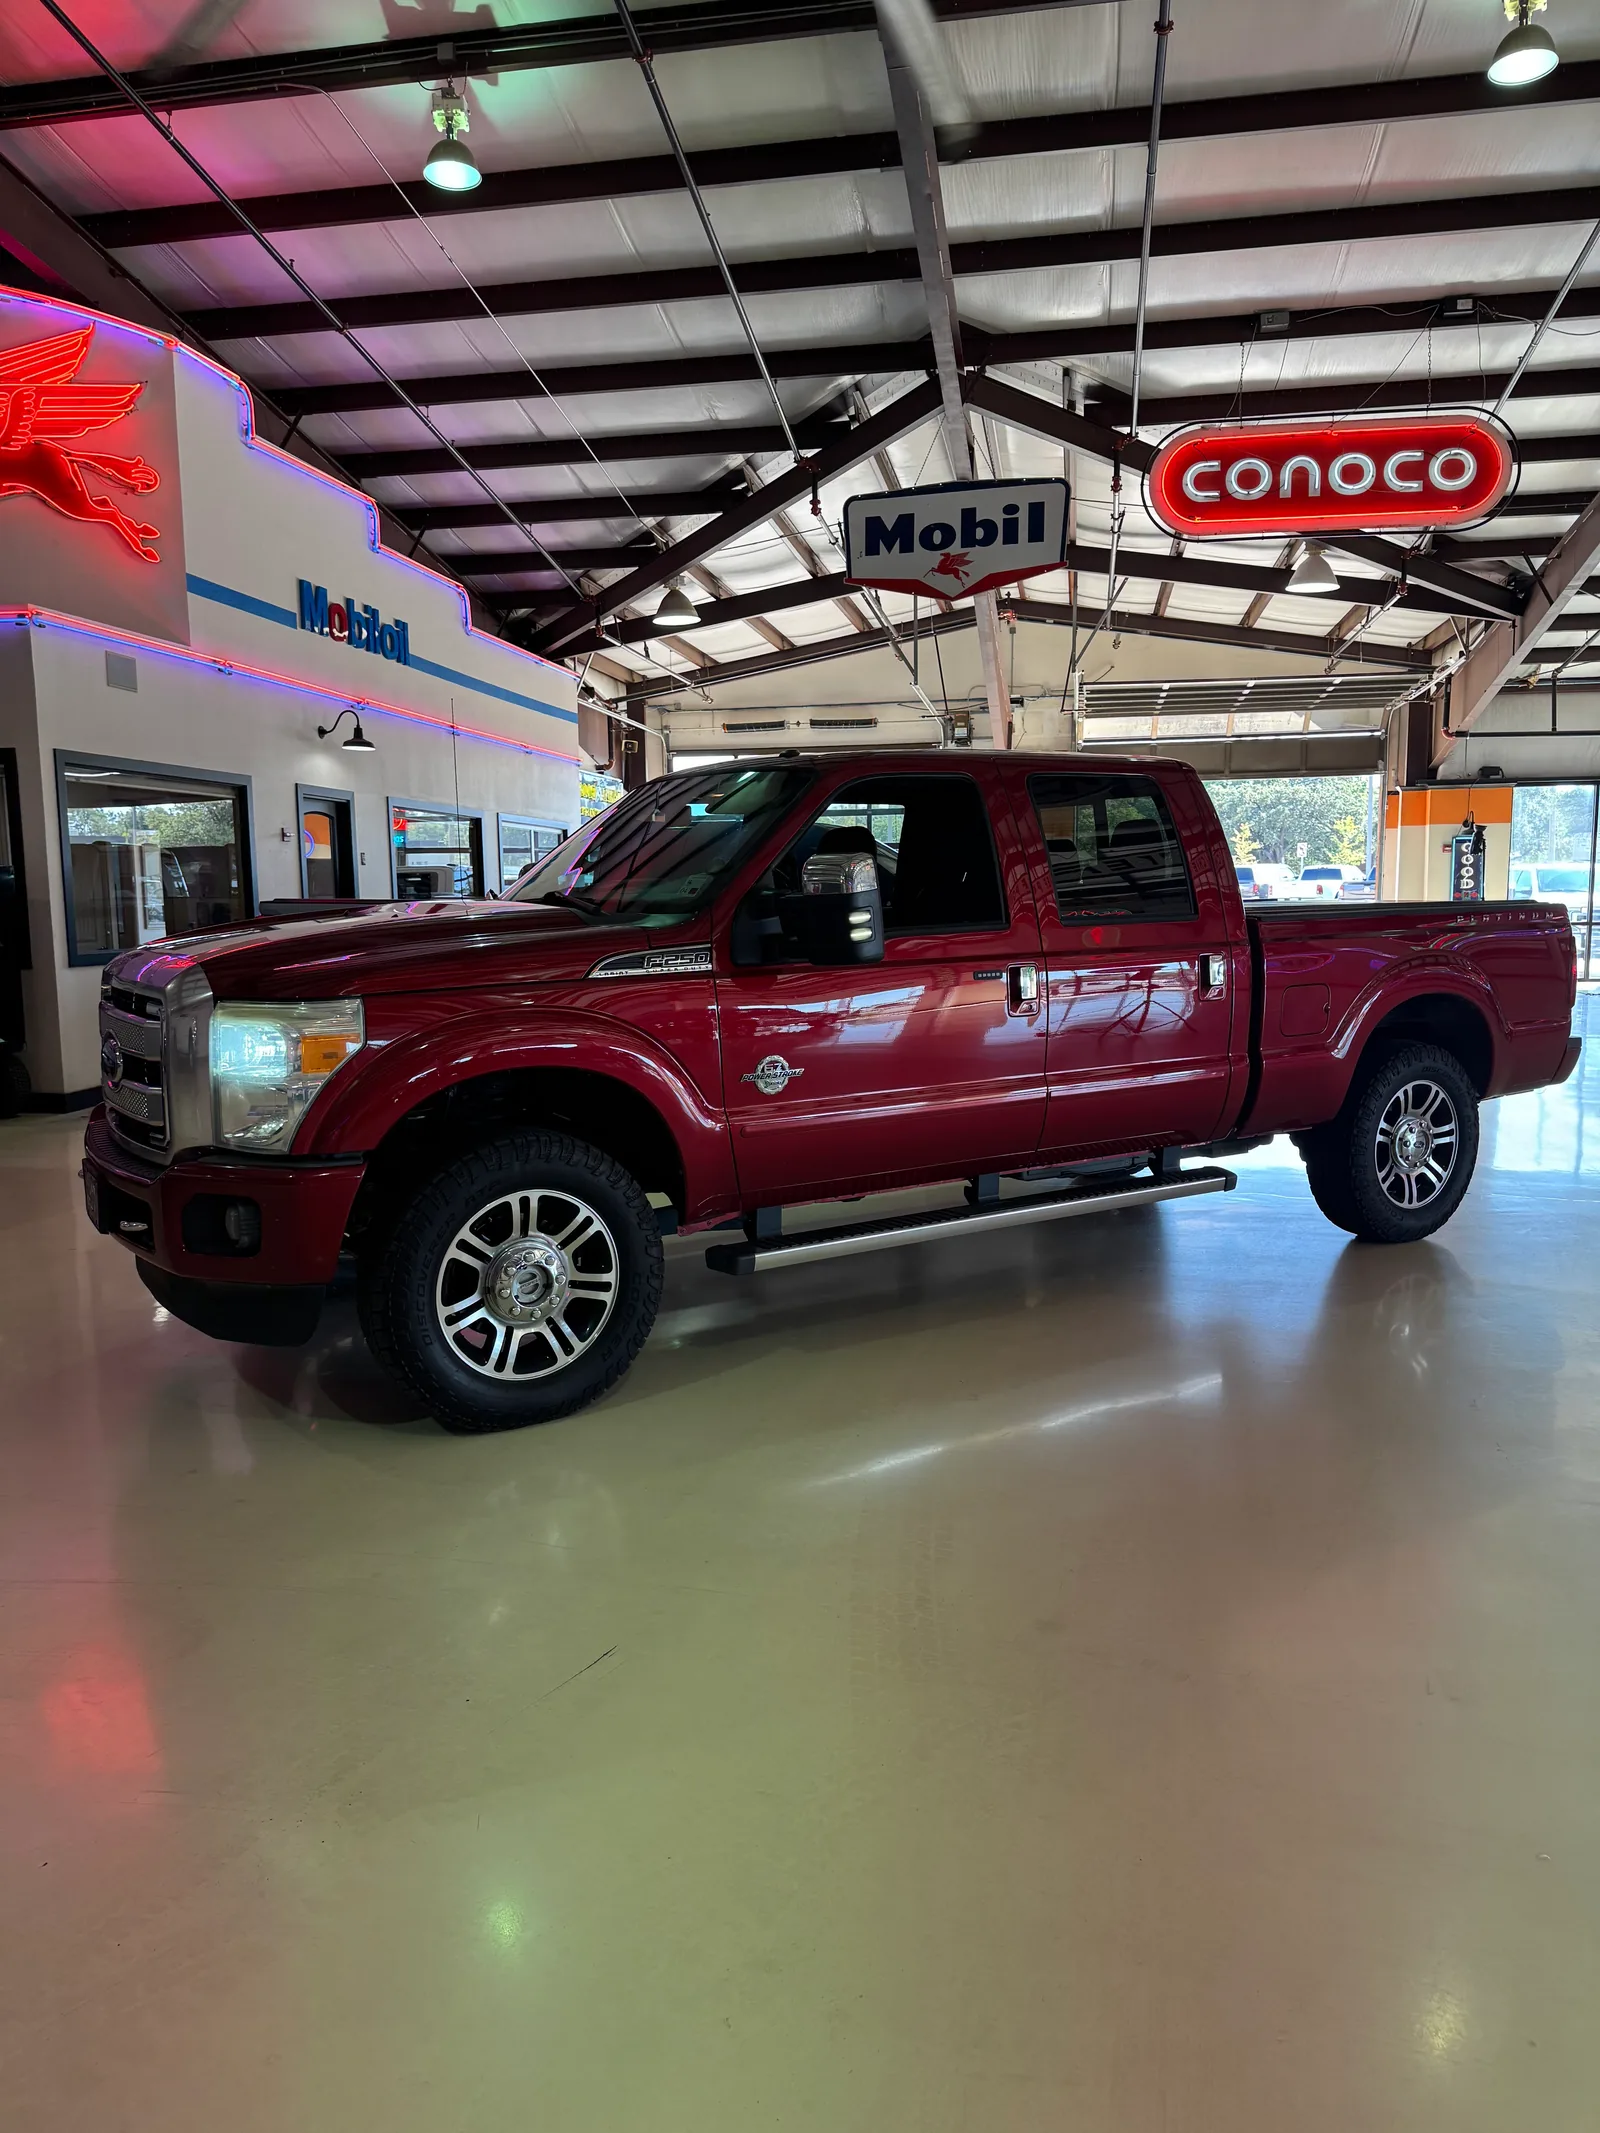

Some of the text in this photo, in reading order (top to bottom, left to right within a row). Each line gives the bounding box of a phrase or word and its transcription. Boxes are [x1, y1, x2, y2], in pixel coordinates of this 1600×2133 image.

[1182, 447, 1478, 503] CONOCO
[864, 500, 1046, 557] Mobil
[298, 578, 411, 667] Mobiloil
[412, 1211, 457, 1347] DISCOVERER
[602, 1271, 644, 1364] COOPER
